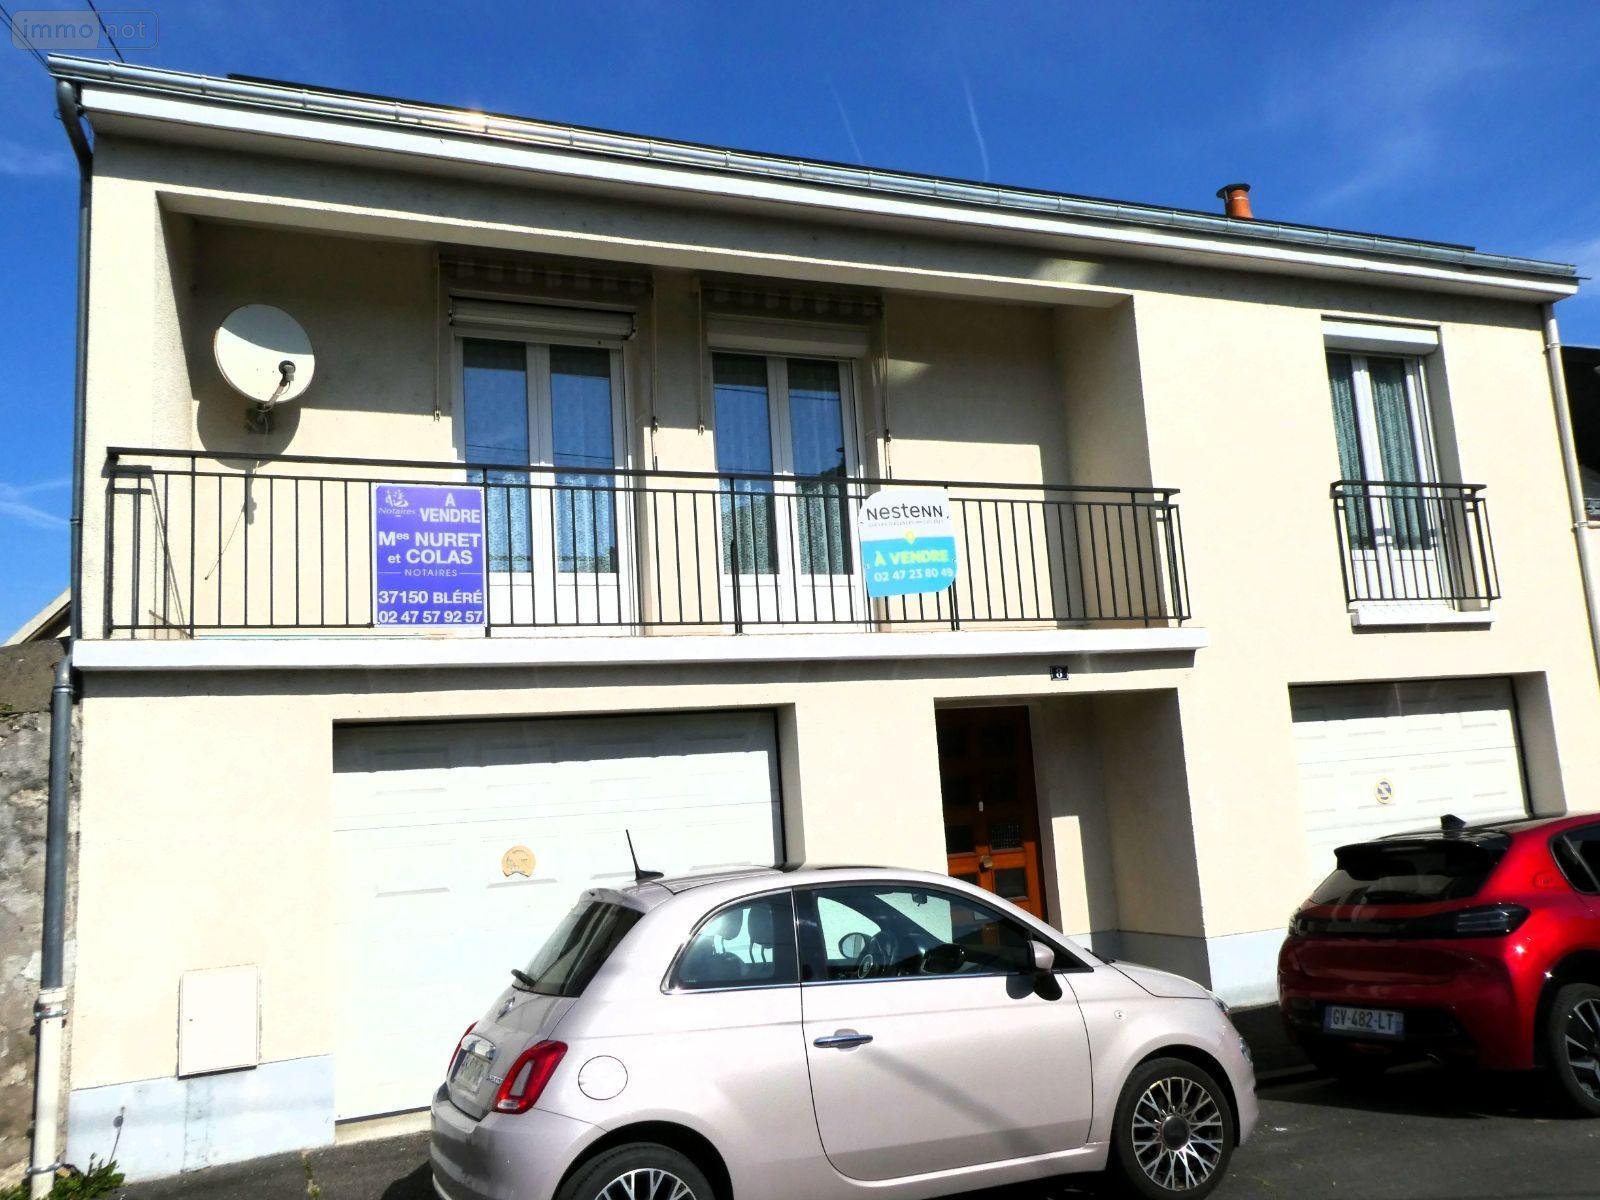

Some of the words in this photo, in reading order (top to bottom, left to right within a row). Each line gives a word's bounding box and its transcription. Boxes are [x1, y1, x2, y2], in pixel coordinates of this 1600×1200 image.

[419, 507, 481, 524] VENDRE
[378, 531, 410, 546] Mes
[415, 531, 481, 548] NURET
[387, 553, 401, 564] et
[405, 548, 473, 565] COLAS
[888, 549, 950, 566] VENDRE
[404, 568, 458, 577] NOTAIRES
[874, 571, 890, 582] 02
[892, 569, 906, 580] 47
[908, 568, 923, 579] 23
[378, 590, 429, 604] 37150
[432, 589, 483, 604] BLÉRÉ
[378, 610, 398, 623] 02
[400, 610, 419, 623] 47
[422, 610, 441, 623] 57
[443, 610, 462, 623] 92
[465, 610, 483, 623] 57
